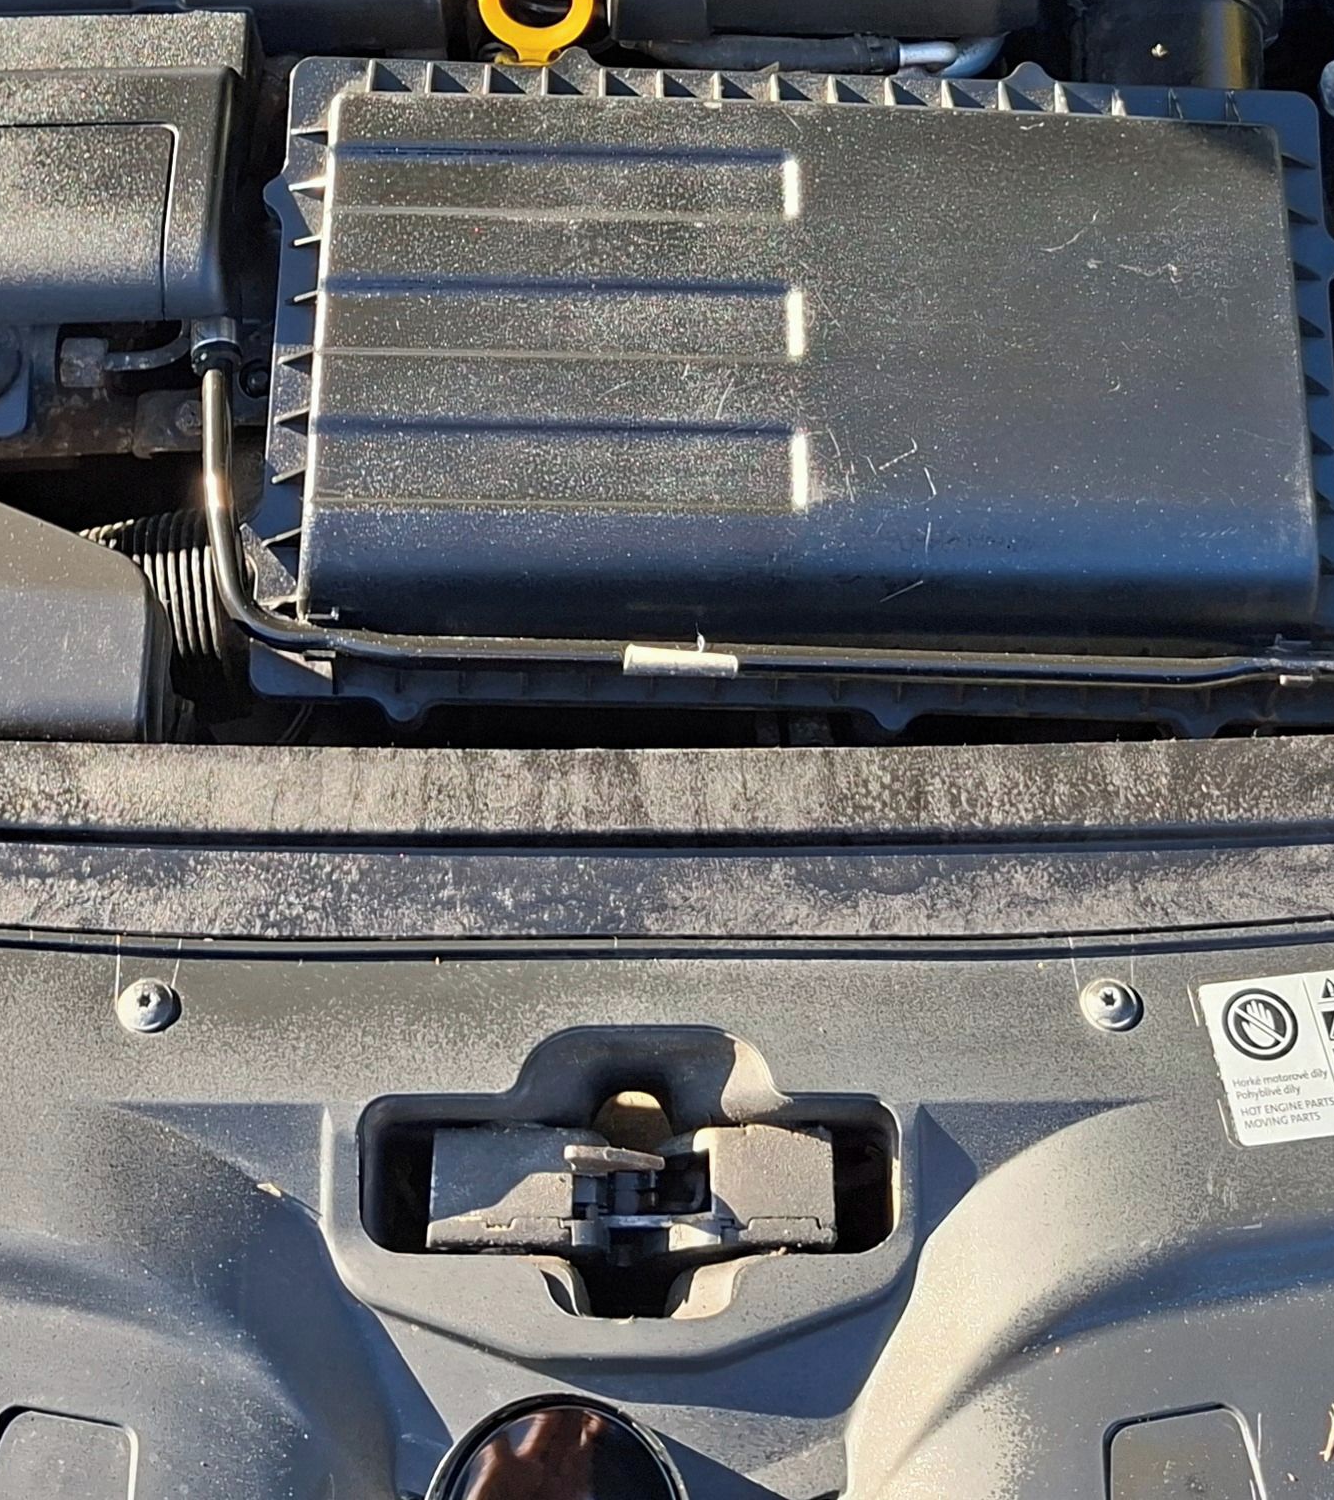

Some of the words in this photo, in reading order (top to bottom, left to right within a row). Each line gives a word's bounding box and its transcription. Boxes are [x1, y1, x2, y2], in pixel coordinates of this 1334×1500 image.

[1240, 1106, 1262, 1117] HOT
[1264, 1101, 1304, 1114] ENGINE
[1244, 1116, 1289, 1129] MOVING
[1291, 1111, 1321, 1123] PARTS
